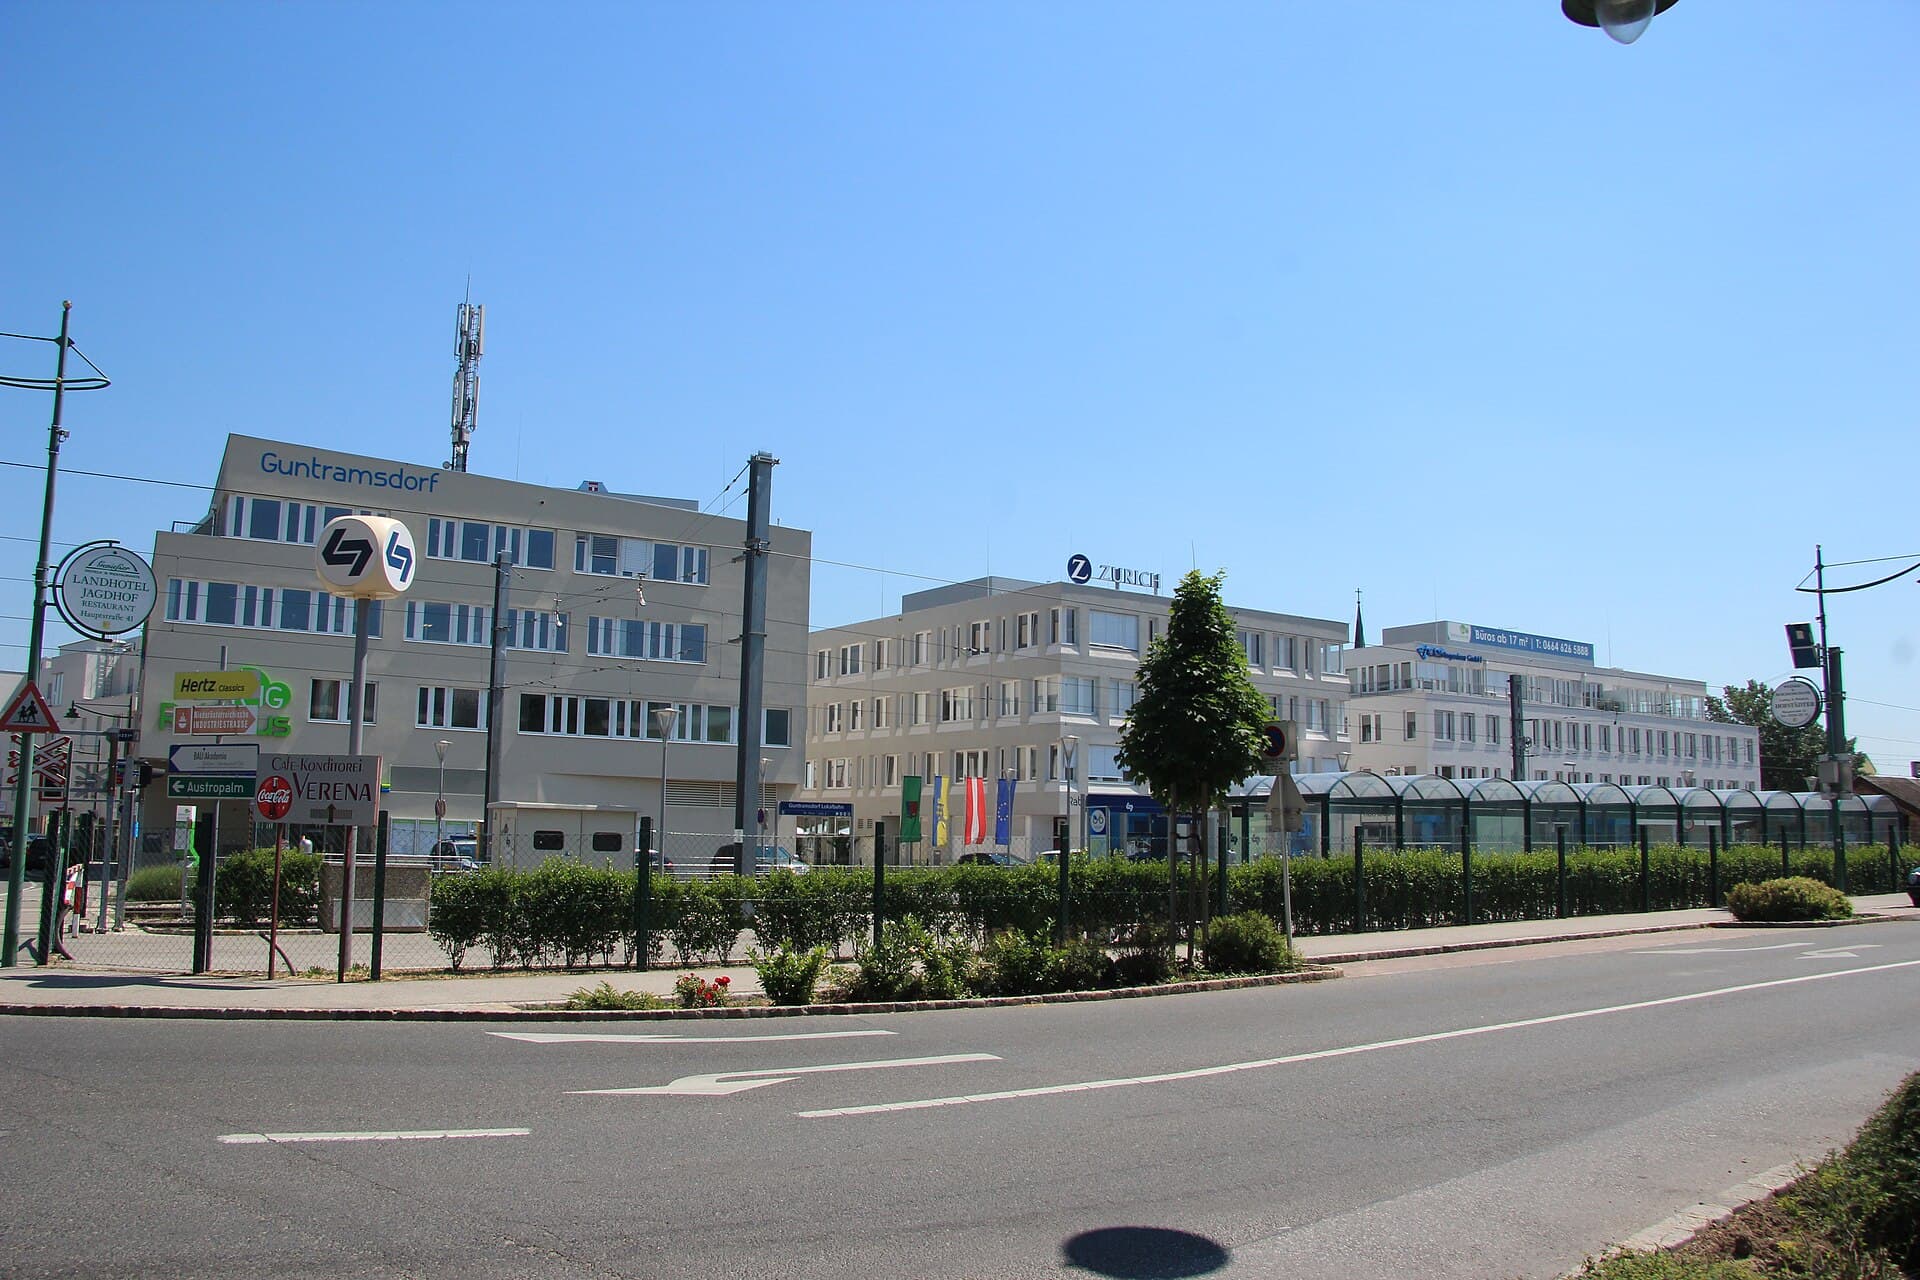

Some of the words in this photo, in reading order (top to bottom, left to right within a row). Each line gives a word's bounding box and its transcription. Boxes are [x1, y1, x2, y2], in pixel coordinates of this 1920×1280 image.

[261, 453, 439, 492] Guntramsdorf
[73, 575, 149, 592] LANDHOTEL
[1099, 565, 1160, 588] ZURICH
[80, 588, 138, 602] JAGDHOF
[81, 599, 136, 613] RESTAURANT
[1475, 629, 1495, 643] Büros
[1496, 634, 1507, 644] ab
[1509, 634, 1517, 645] 17
[1542, 640, 1559, 652] 0664
[1560, 643, 1572, 654] 626
[180, 678, 216, 693] Hertz
[218, 684, 245, 692] Classics
[187, 781, 244, 797] Austropalm
[292, 772, 371, 801] VERENA
